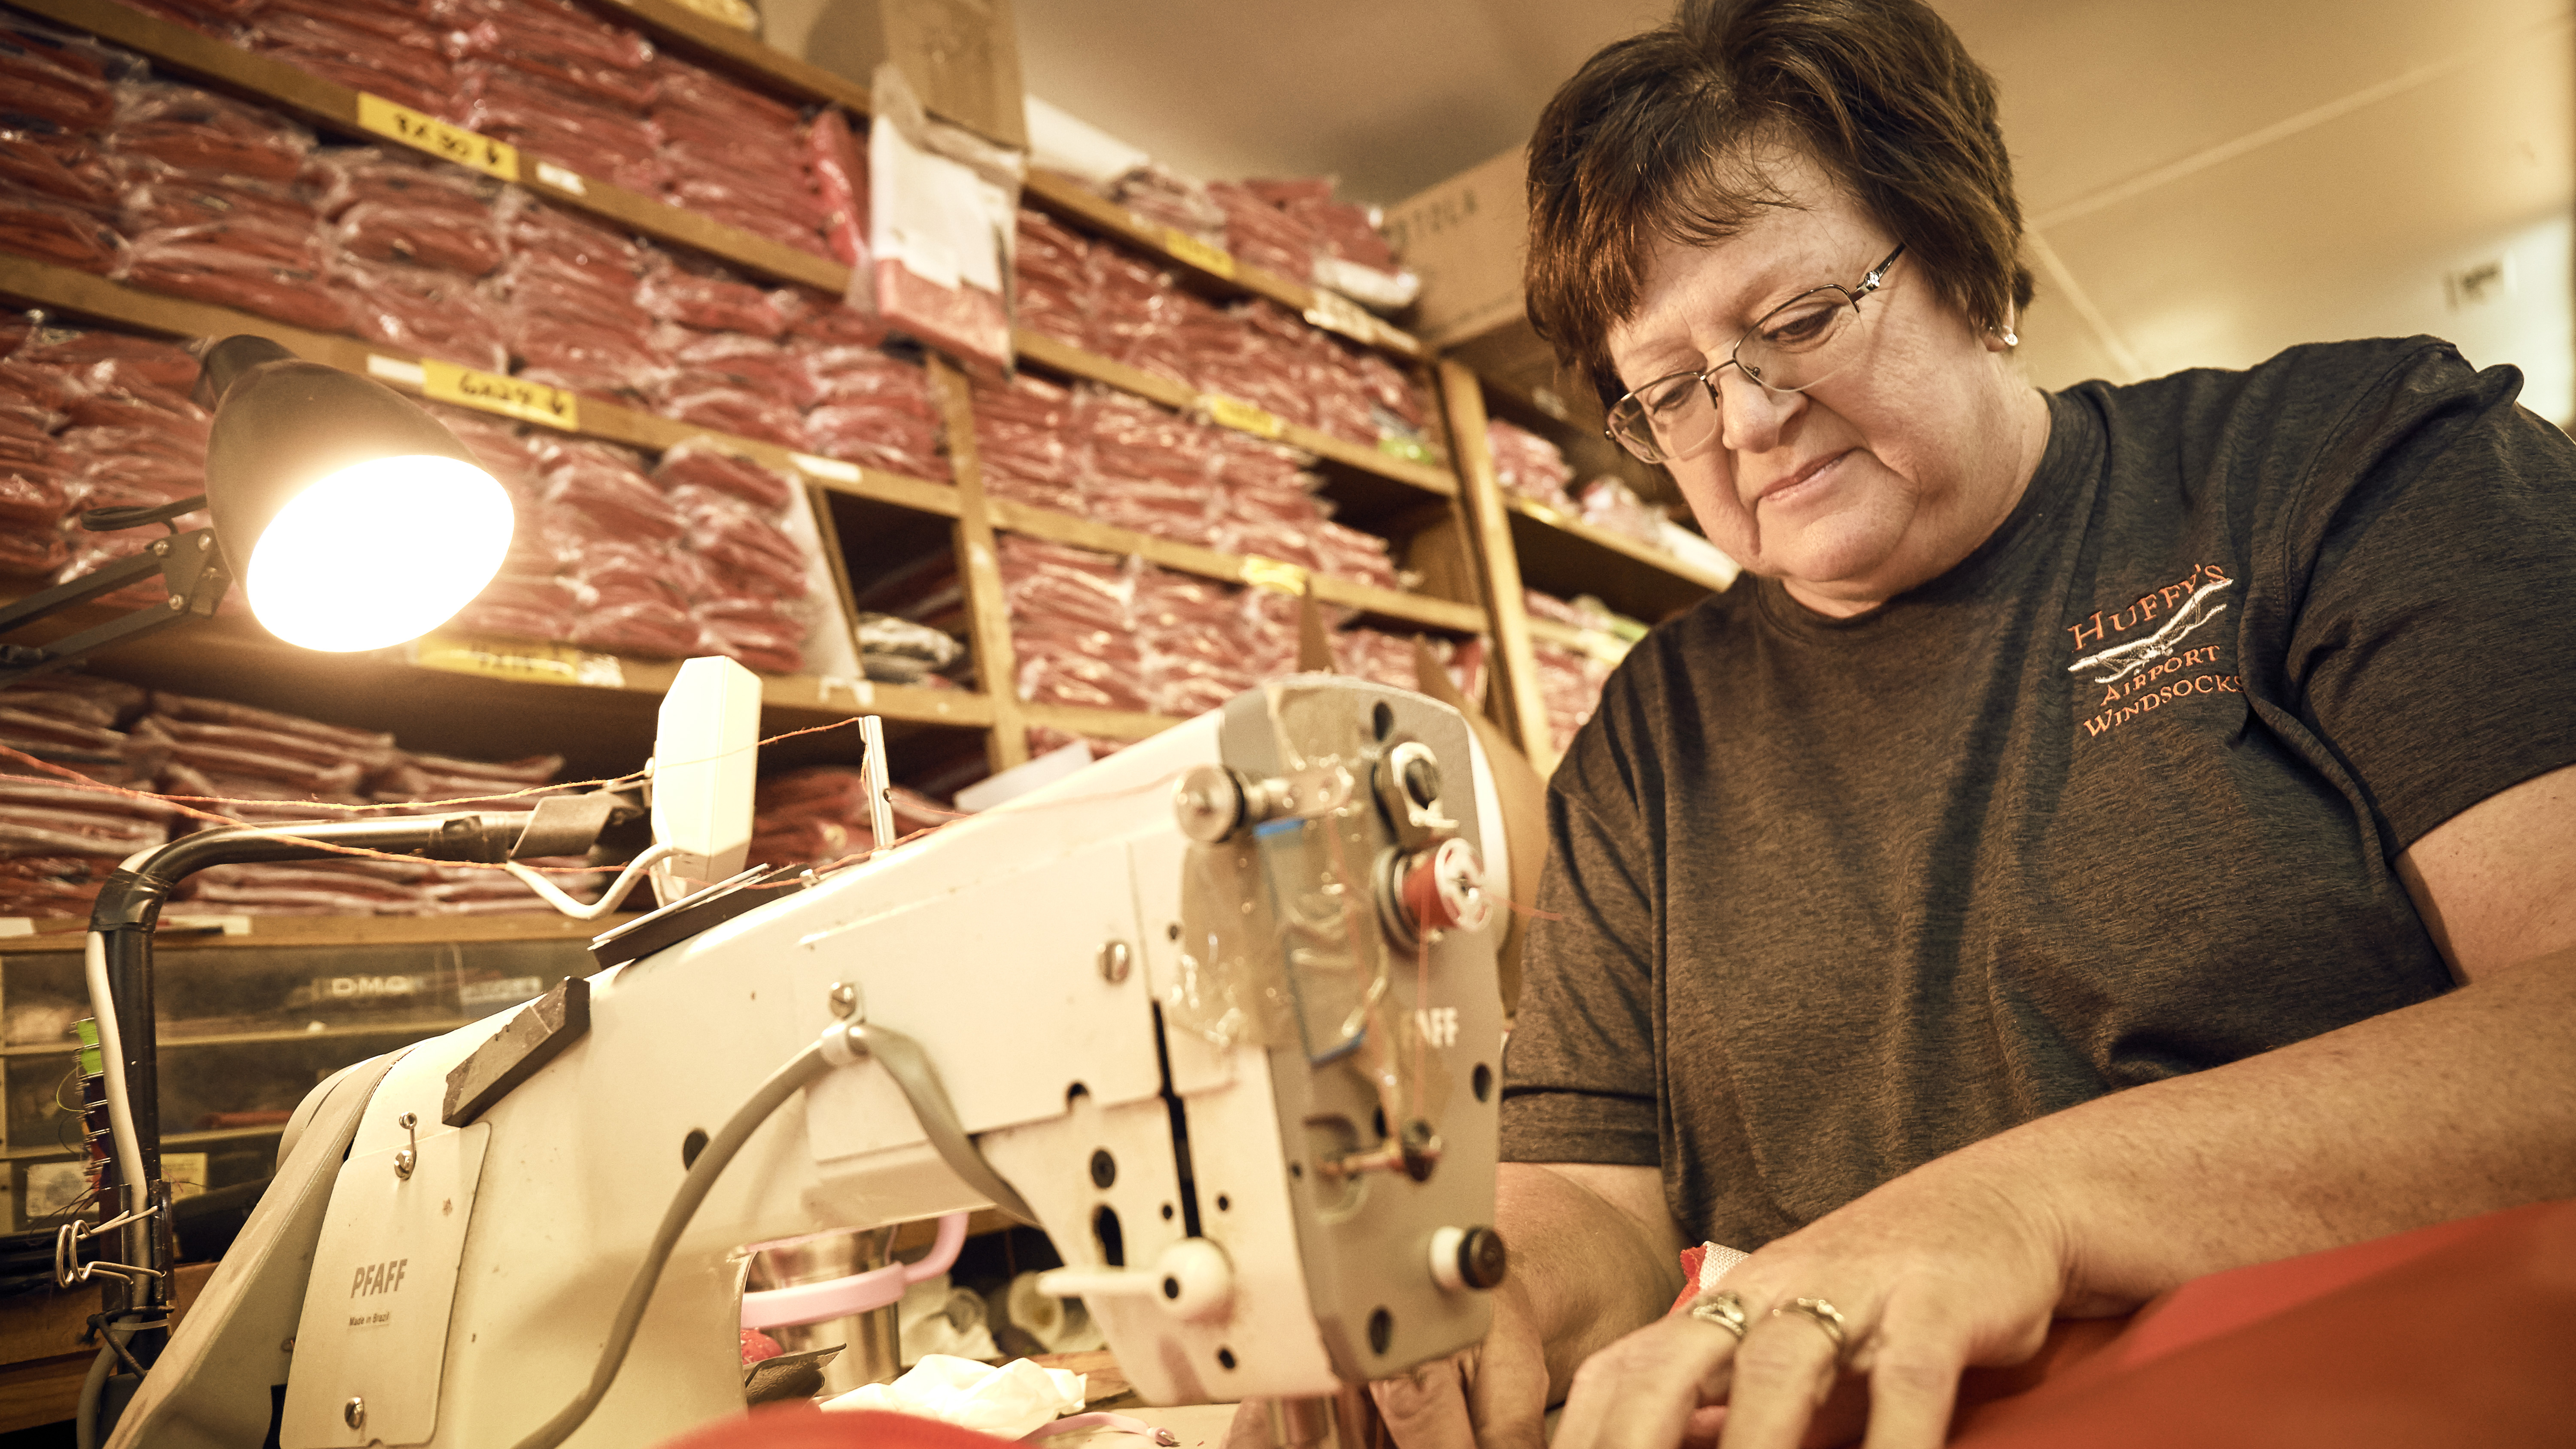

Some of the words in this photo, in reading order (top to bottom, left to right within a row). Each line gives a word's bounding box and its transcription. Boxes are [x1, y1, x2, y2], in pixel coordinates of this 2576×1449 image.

[2067, 564, 2228, 653] HUFFY'S
[2100, 645, 2220, 707] AIRPORT
[350, 1258, 408, 1299] PFAFF
[349, 1316, 365, 1326] Made
[366, 1315, 371, 1324] in
[372, 1311, 390, 1324] Brazil
